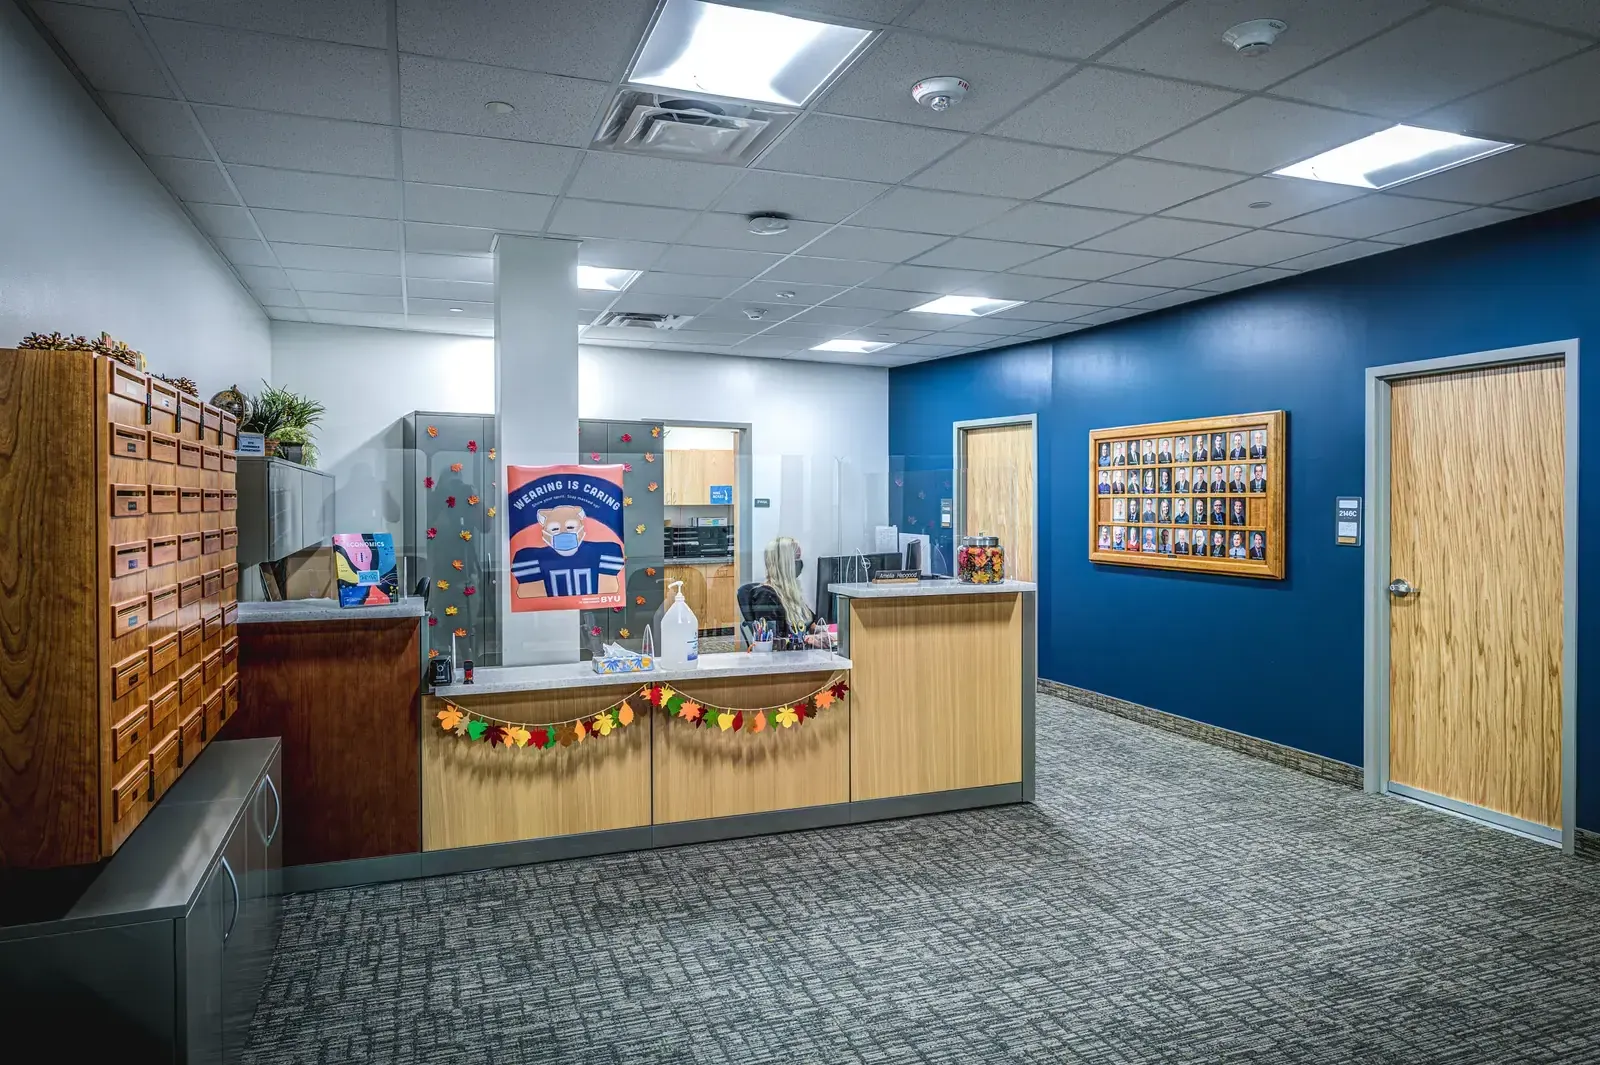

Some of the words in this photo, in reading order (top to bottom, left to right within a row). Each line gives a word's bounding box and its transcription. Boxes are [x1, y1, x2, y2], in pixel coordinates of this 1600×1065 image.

[513, 481, 563, 510] WEARING
[568, 480, 579, 490] IS
[583, 484, 621, 511] CARING
[600, 595, 621, 603] BYU
